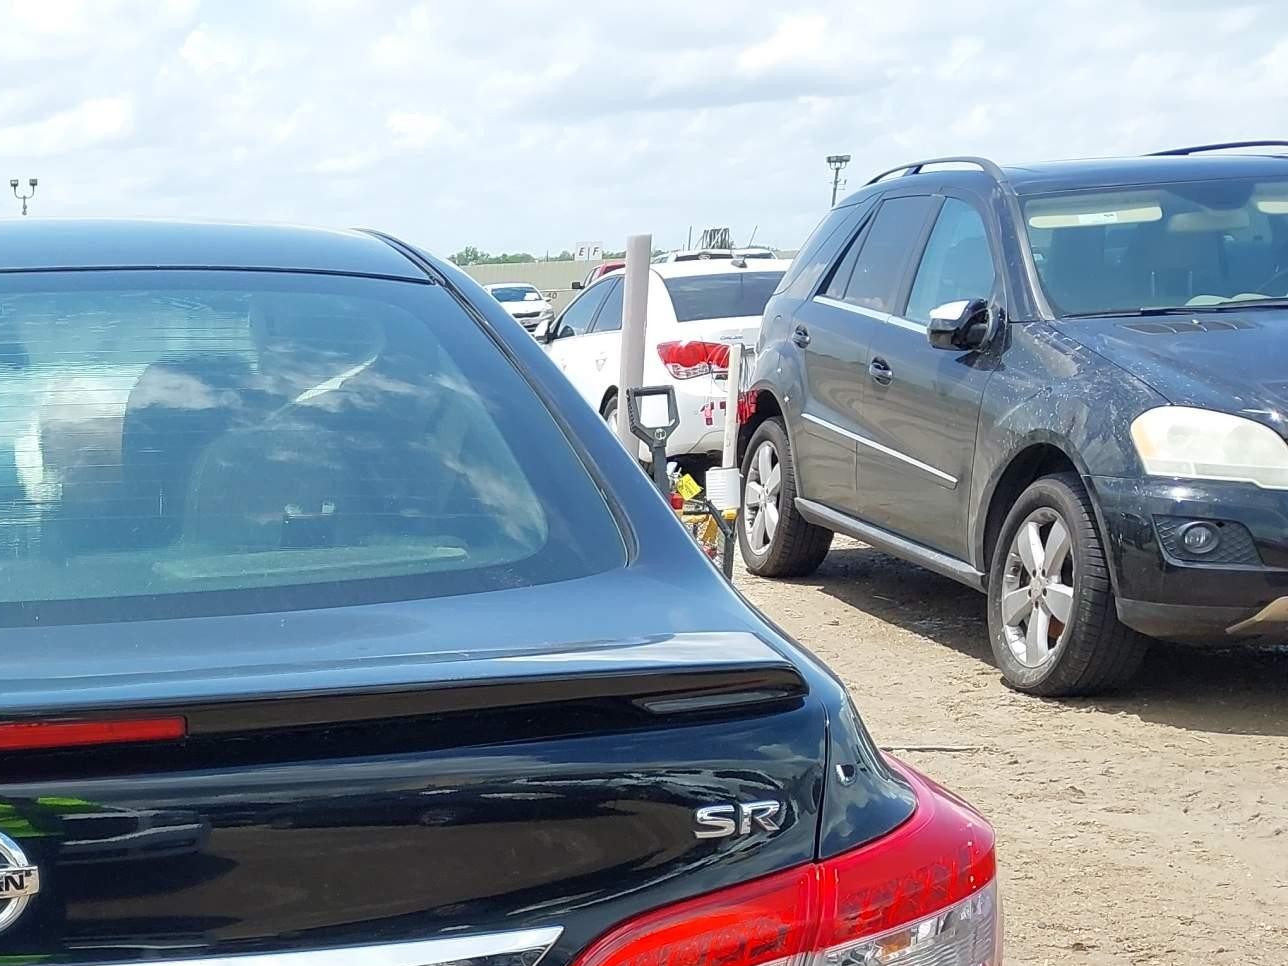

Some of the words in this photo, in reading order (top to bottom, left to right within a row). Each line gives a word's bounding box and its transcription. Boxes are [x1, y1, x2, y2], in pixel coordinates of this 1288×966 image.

[578, 247, 585, 256] E
[592, 246, 600, 256] F
[694, 800, 780, 839] SR
